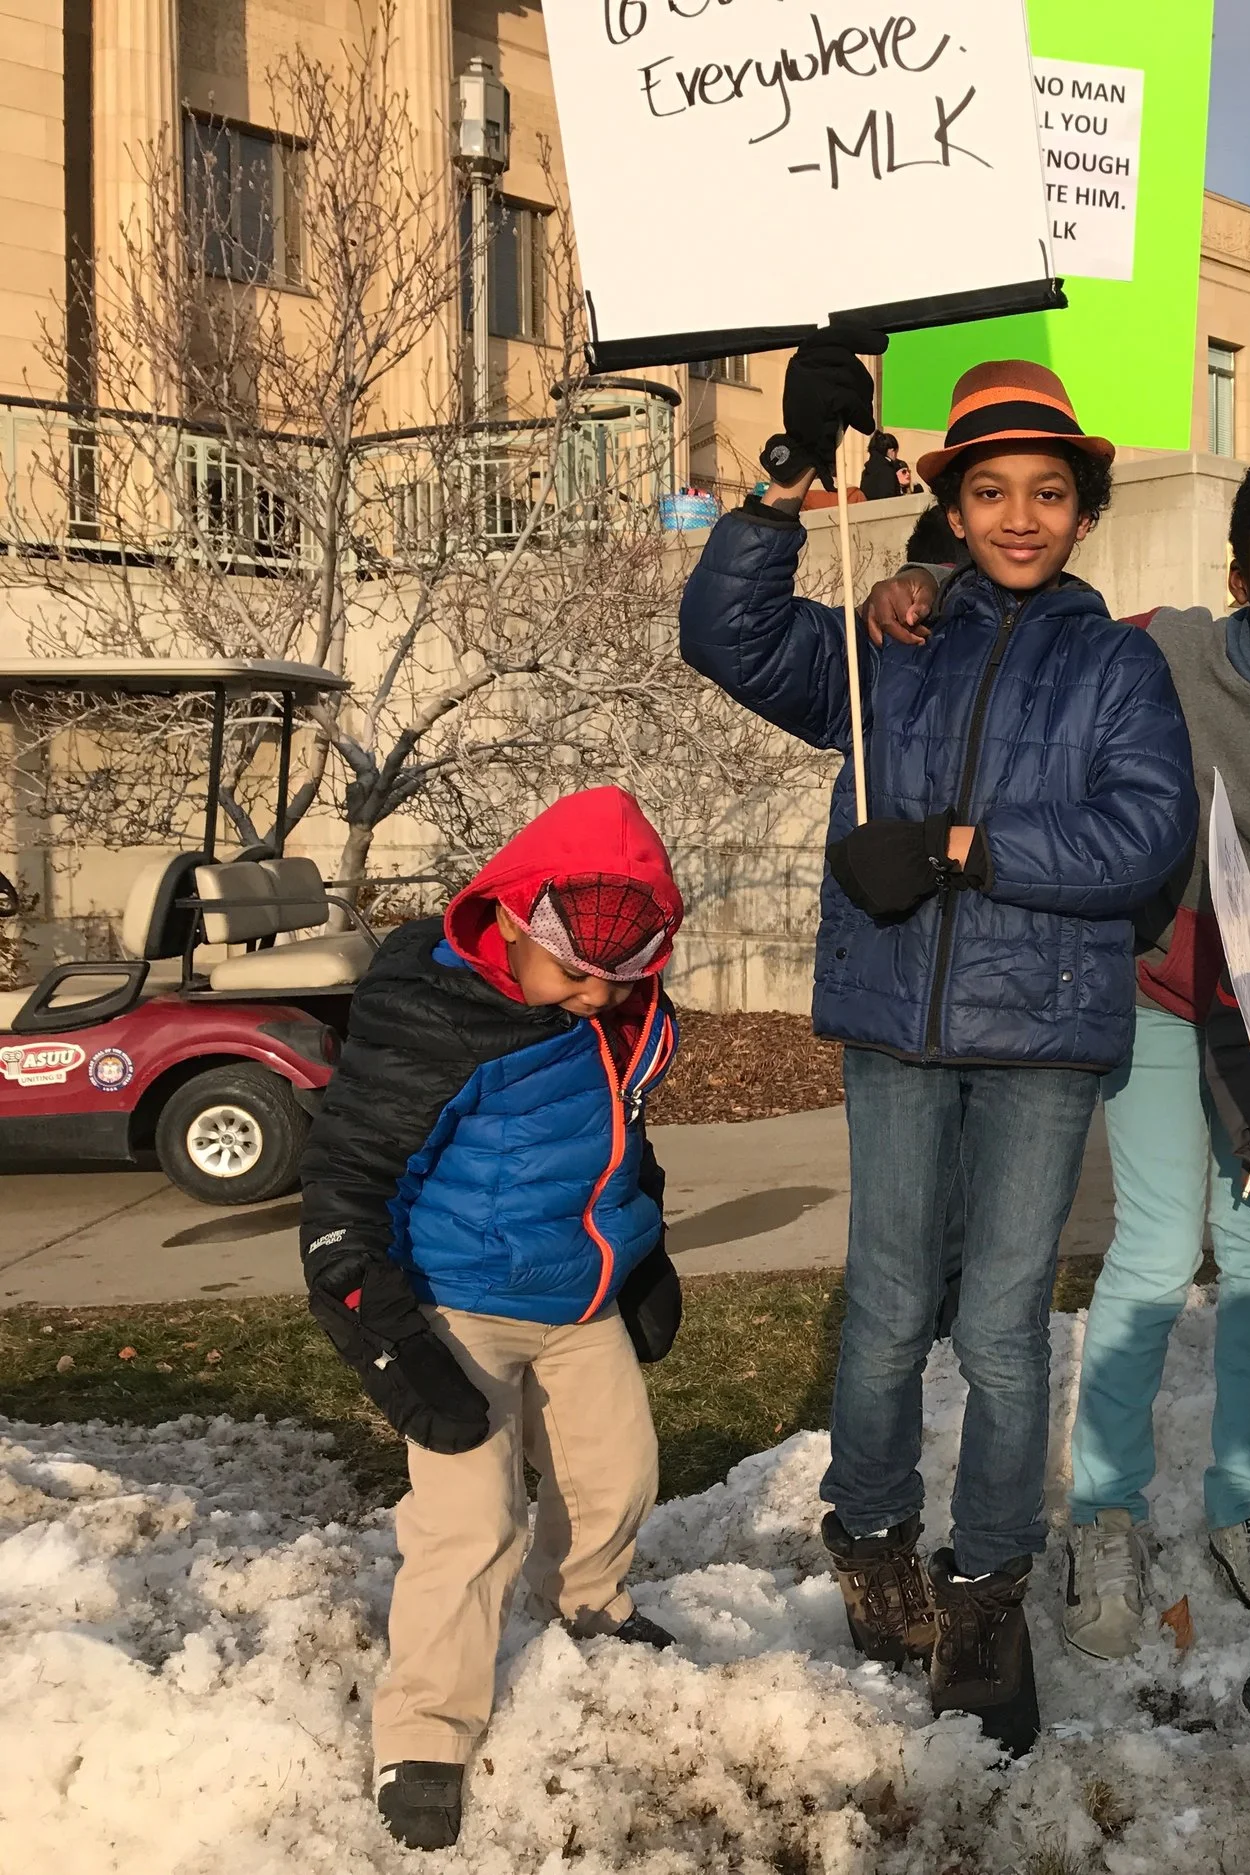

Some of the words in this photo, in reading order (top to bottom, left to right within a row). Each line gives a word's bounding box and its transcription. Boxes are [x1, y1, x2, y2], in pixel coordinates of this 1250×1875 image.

[637, 13, 968, 145] Everywhere.
[1034, 75, 1064, 97] NO
[1071, 80, 1126, 104] MAN
[1061, 112, 1108, 136] YOU
[1041, 148, 1130, 177] NOUGH
[1045, 183, 1069, 204] TE
[1075, 186, 1127, 210] HIM.
[1052, 220, 1078, 241] LK
[22, 1049, 75, 1068] ASUU
[21, 1074, 55, 1084] UNITING
